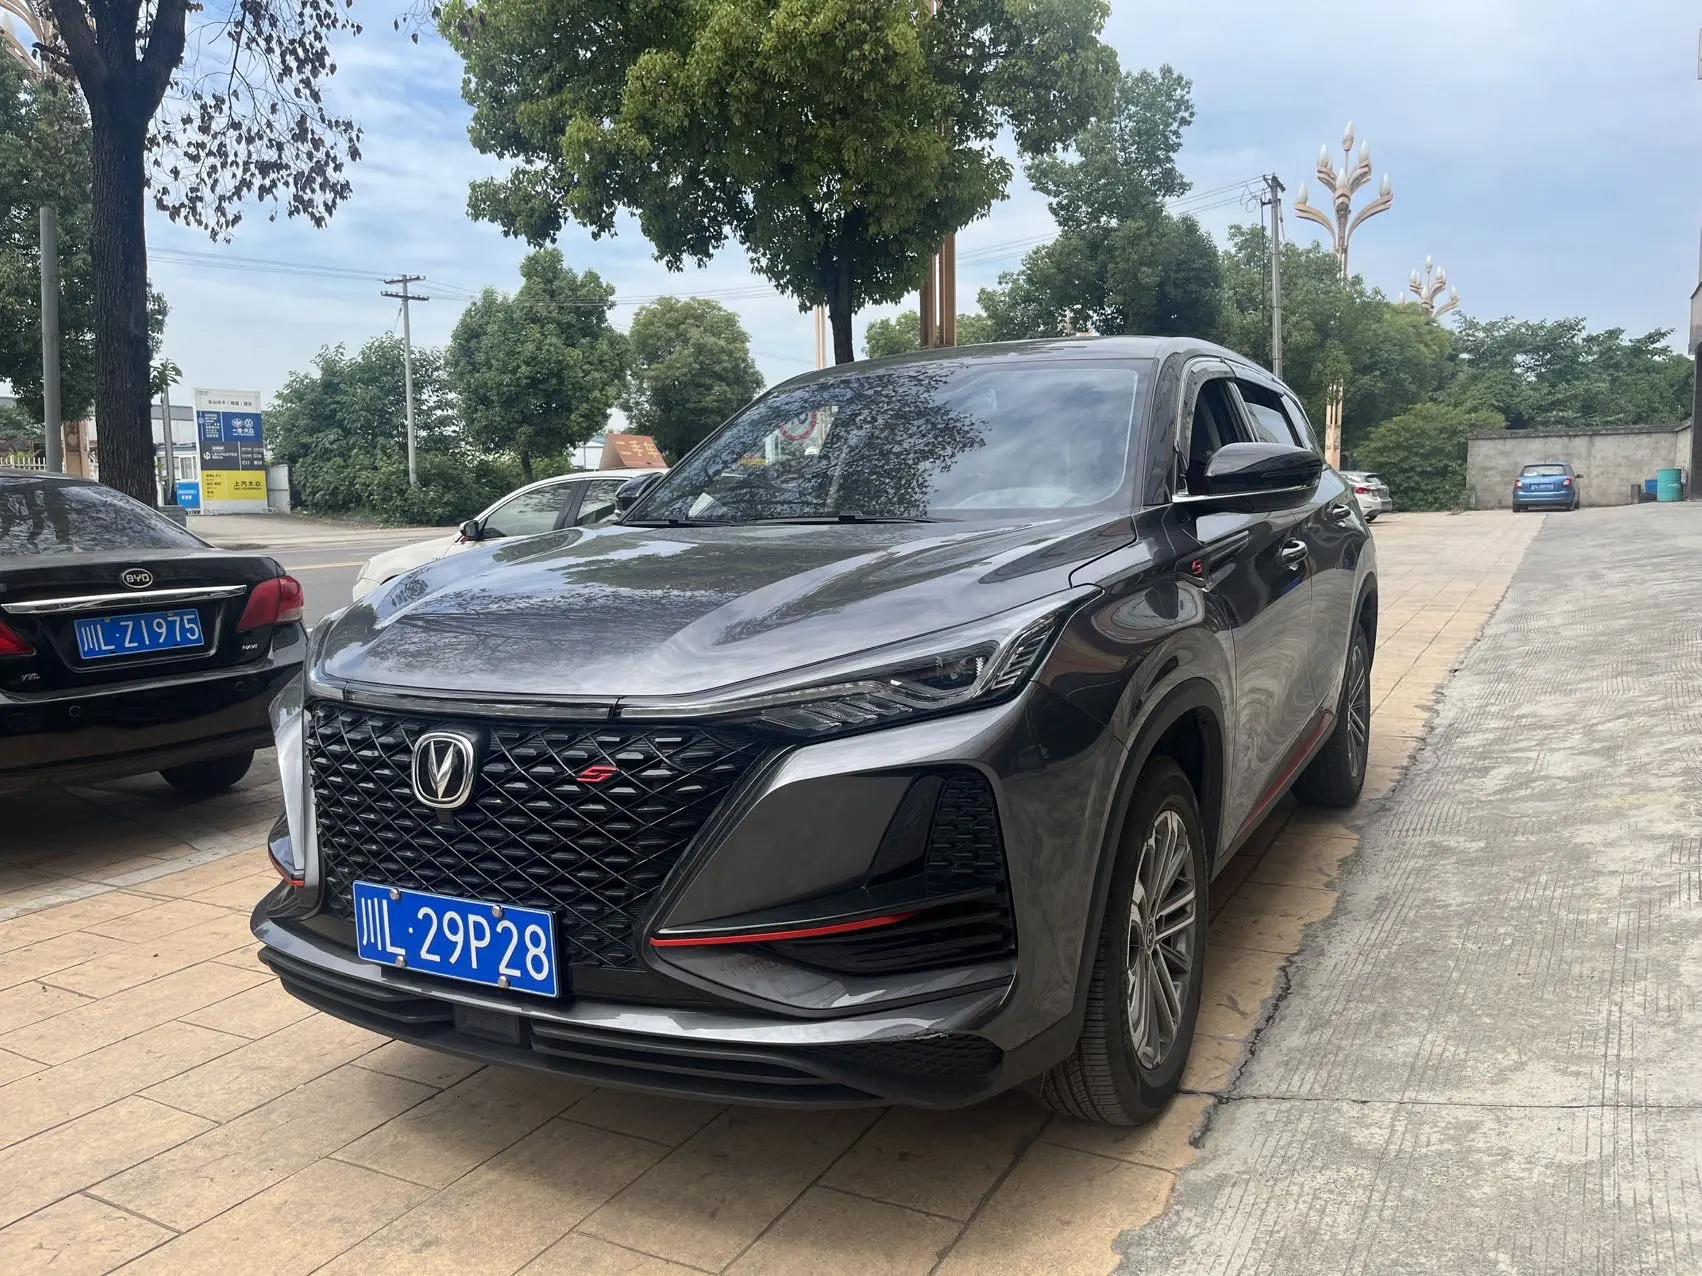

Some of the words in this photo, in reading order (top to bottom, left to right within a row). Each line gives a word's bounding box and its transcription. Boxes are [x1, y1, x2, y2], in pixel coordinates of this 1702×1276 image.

[616, 440, 658, 458] 二手车
[126, 573, 150, 583] BYD
[361, 897, 549, 982] 川L·29P28
